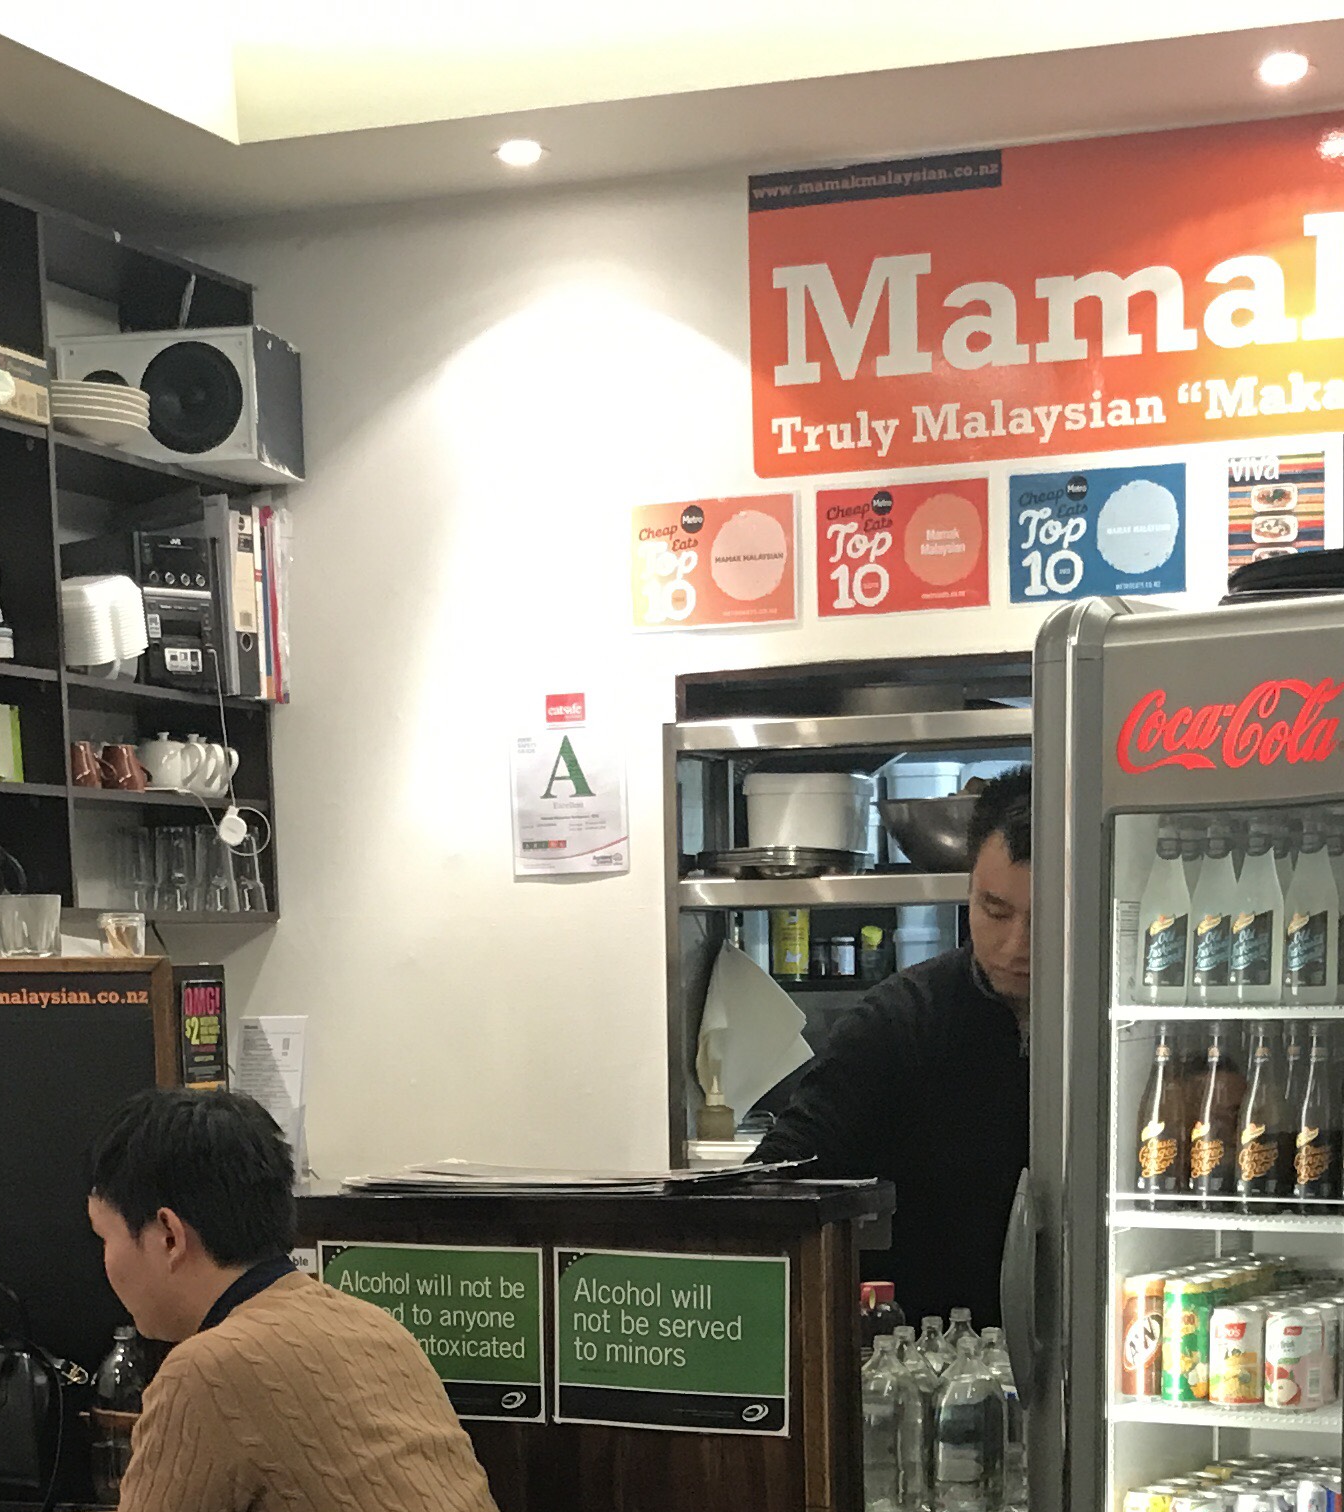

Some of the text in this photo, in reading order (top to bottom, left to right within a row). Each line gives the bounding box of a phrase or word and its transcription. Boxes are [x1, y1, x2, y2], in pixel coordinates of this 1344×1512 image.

[751, 161, 1000, 201] www.mamakmalaysian.co.nz
[771, 412, 900, 456] Truly
[911, 390, 1167, 451] Malaysian
[827, 503, 870, 520] Cheap
[1018, 489, 1064, 507] Cheap
[1057, 504, 1088, 518] Eats
[639, 524, 678, 541] Cheap
[682, 515, 703, 525] Metro
[863, 518, 893, 533] Eats
[1018, 507, 1087, 549] Top
[672, 538, 698, 551] Eats
[827, 522, 892, 563] Top
[830, 563, 890, 609] 10
[1022, 549, 1084, 596] 10
[642, 579, 697, 623] 10
[540, 735, 596, 799] A
[184, 987, 221, 1015] OMG!
[185, 1017, 200, 1045] $2
[339, 1269, 525, 1299] Alcohol will not be
[574, 1277, 711, 1310] Alcohol will
[412, 1303, 432, 1326] to
[440, 1309, 515, 1332] anyone
[574, 1309, 742, 1341] not be served
[415, 1333, 525, 1359] ntoxicated
[574, 1336, 686, 1367] to minors
